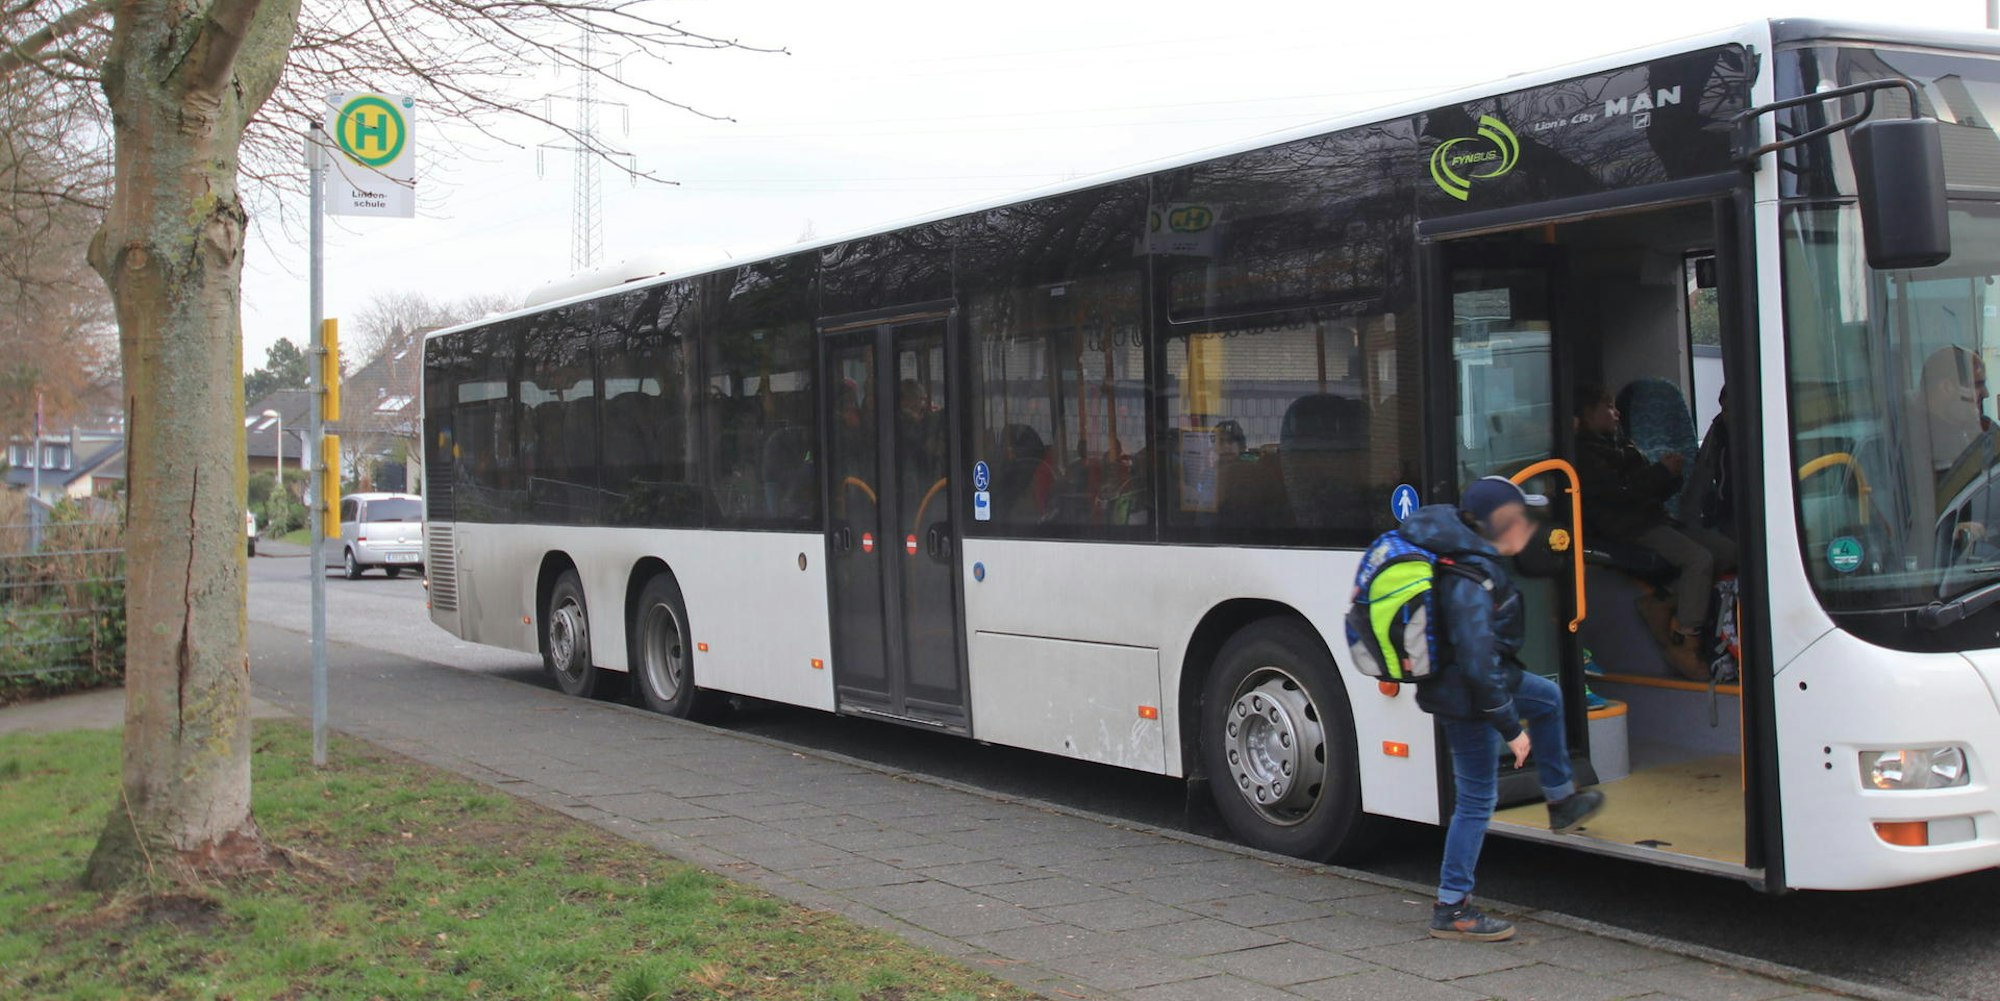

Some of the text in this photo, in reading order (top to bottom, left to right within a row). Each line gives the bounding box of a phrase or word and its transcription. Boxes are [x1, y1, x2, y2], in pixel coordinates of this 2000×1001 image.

[1534, 85, 1681, 131] Lion's City MAN
[355, 112, 387, 151] H
[1451, 150, 1497, 167] FYNBUS
[352, 190, 388, 199] Linden-
[354, 200, 386, 208] schule
[1840, 541, 1850, 555] 4
